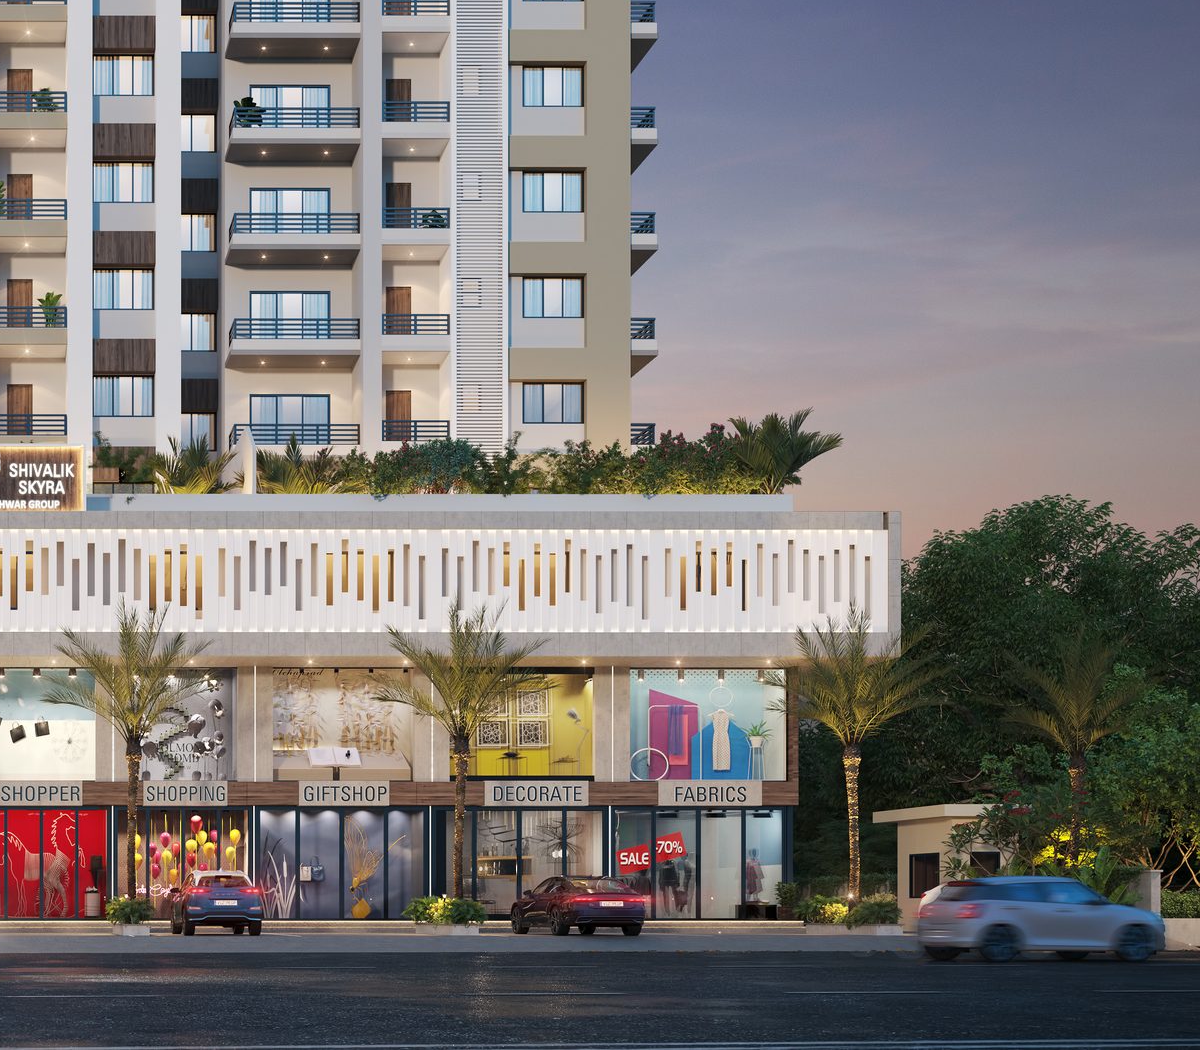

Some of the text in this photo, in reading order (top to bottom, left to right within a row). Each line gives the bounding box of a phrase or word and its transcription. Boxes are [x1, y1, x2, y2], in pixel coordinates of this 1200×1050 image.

[9, 463, 75, 478] SHIVALIK
[18, 480, 65, 495] SKYRA
[29, 500, 60, 509] GROUP
[1, 785, 80, 802] SHOPPER
[146, 785, 226, 802] SHOPPING
[303, 785, 388, 802] GIFTSHOP
[493, 785, 582, 802] DECORATE
[674, 785, 747, 802] FABRICS
[620, 852, 649, 865] SALE
